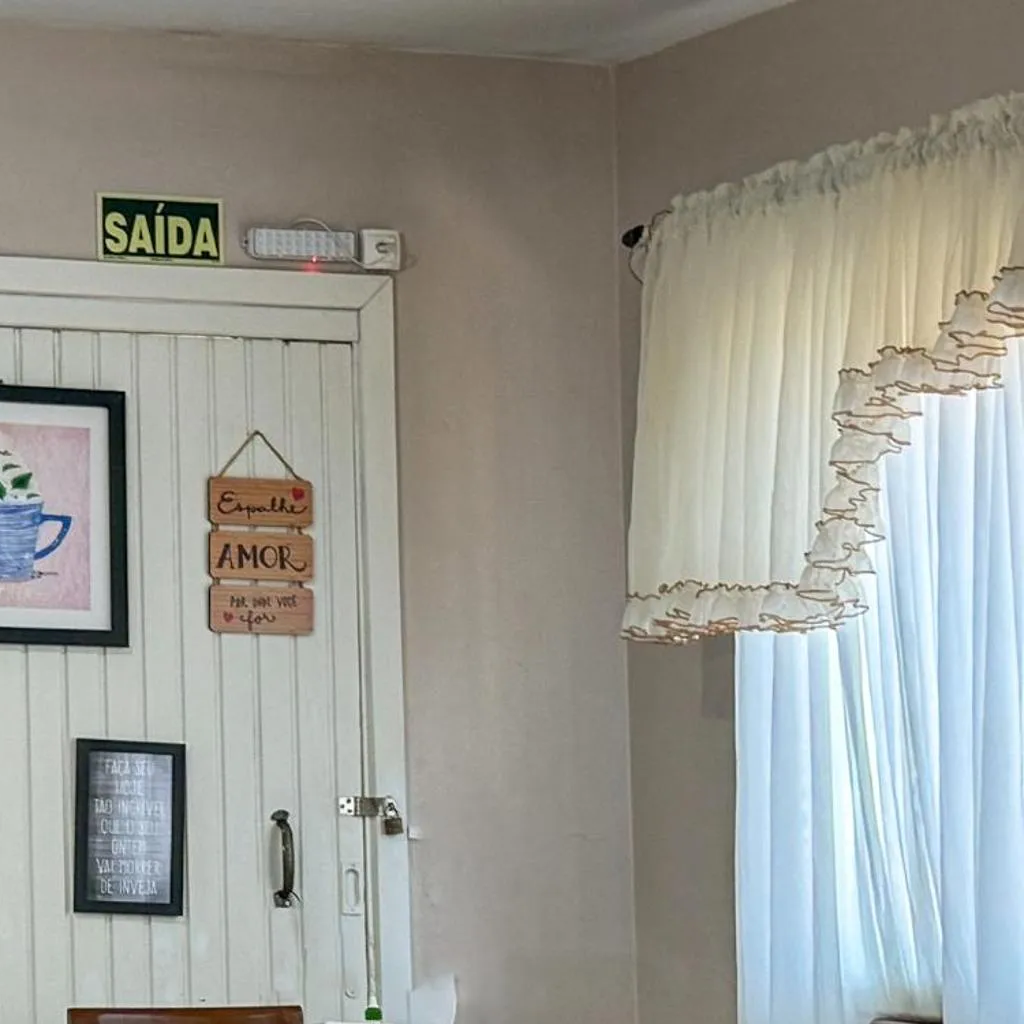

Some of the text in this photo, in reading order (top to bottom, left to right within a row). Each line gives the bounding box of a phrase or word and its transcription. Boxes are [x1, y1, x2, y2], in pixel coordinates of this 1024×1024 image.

[104, 203, 219, 258] SAÍDA
[217, 491, 307, 520] Espalhe
[216, 543, 307, 572] AMOR
[100, 879, 158, 896] DE INVEJA
